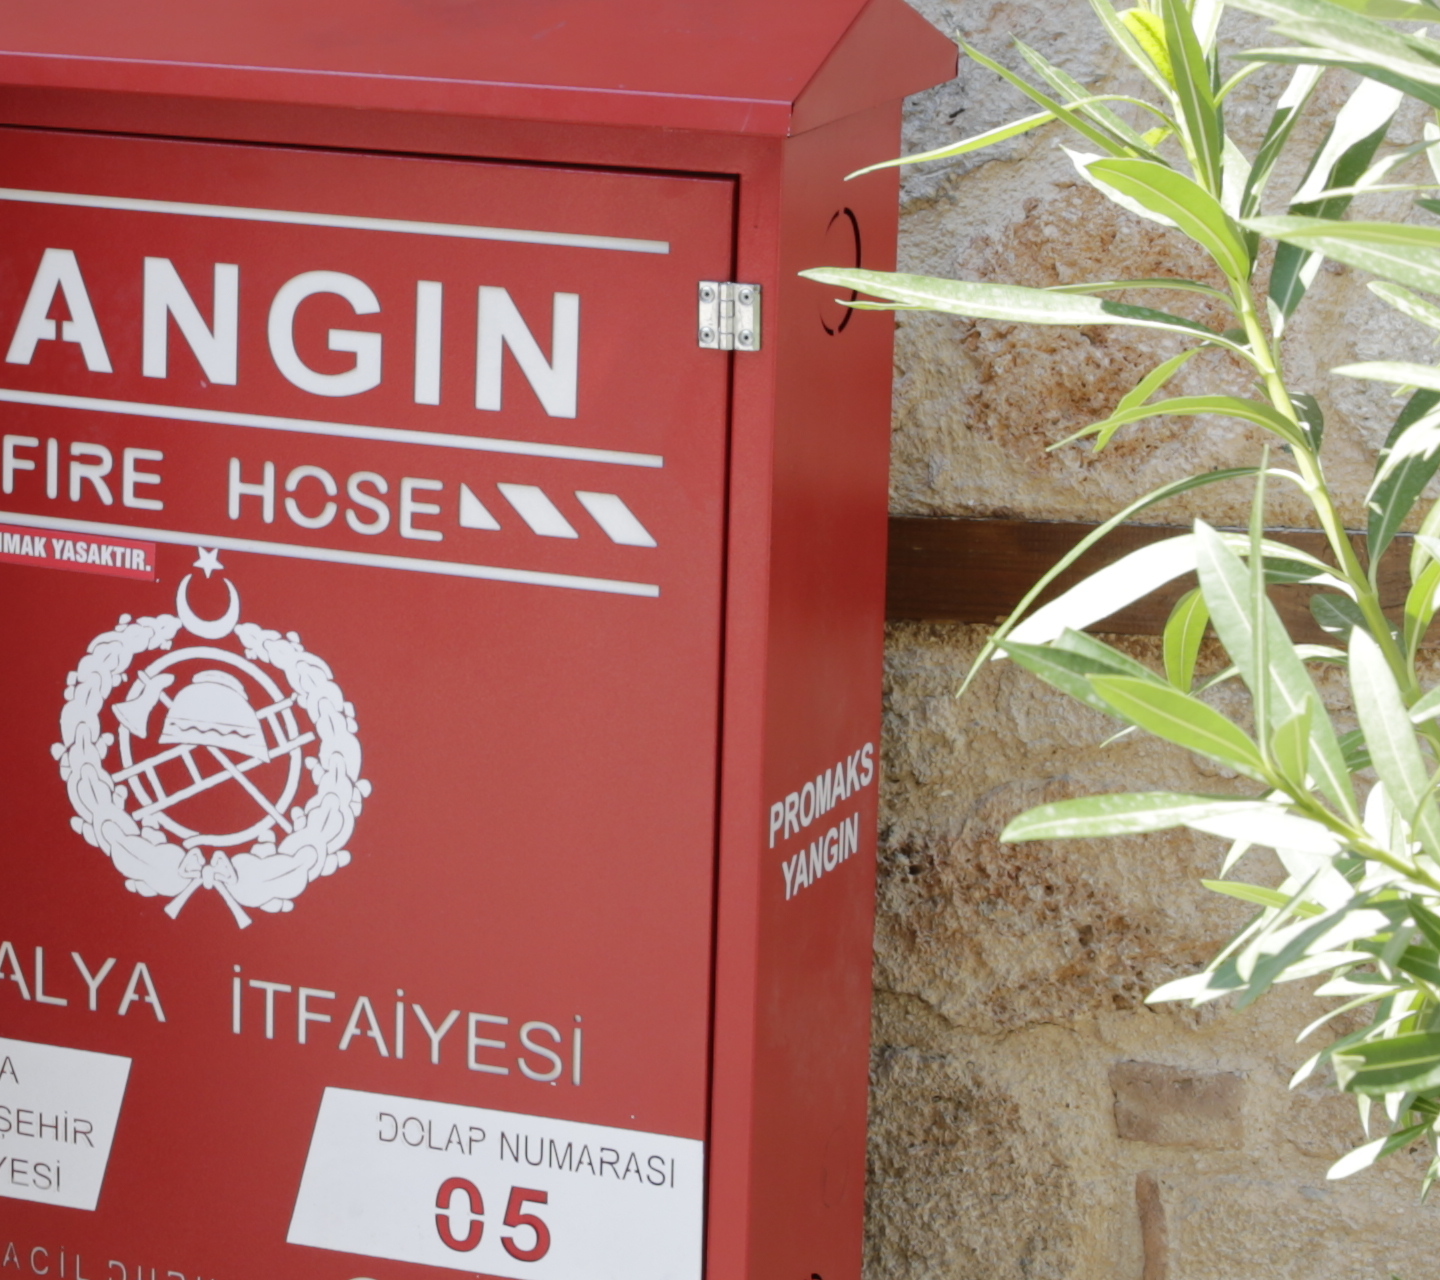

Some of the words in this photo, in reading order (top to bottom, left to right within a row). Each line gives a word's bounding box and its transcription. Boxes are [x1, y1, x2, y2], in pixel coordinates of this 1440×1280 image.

[2, 433, 165, 512] FIRE
[228, 456, 445, 542] HOSE
[51, 538, 152, 572] YASAKTIR.
[769, 741, 874, 849] PROMAKS
[781, 811, 859, 901] YANGIN
[232, 963, 583, 1087] İTFAİYESİ
[378, 1111, 487, 1156] DOLAP
[499, 1130, 676, 1189] NUMARASI
[434, 1176, 552, 1263] 05
